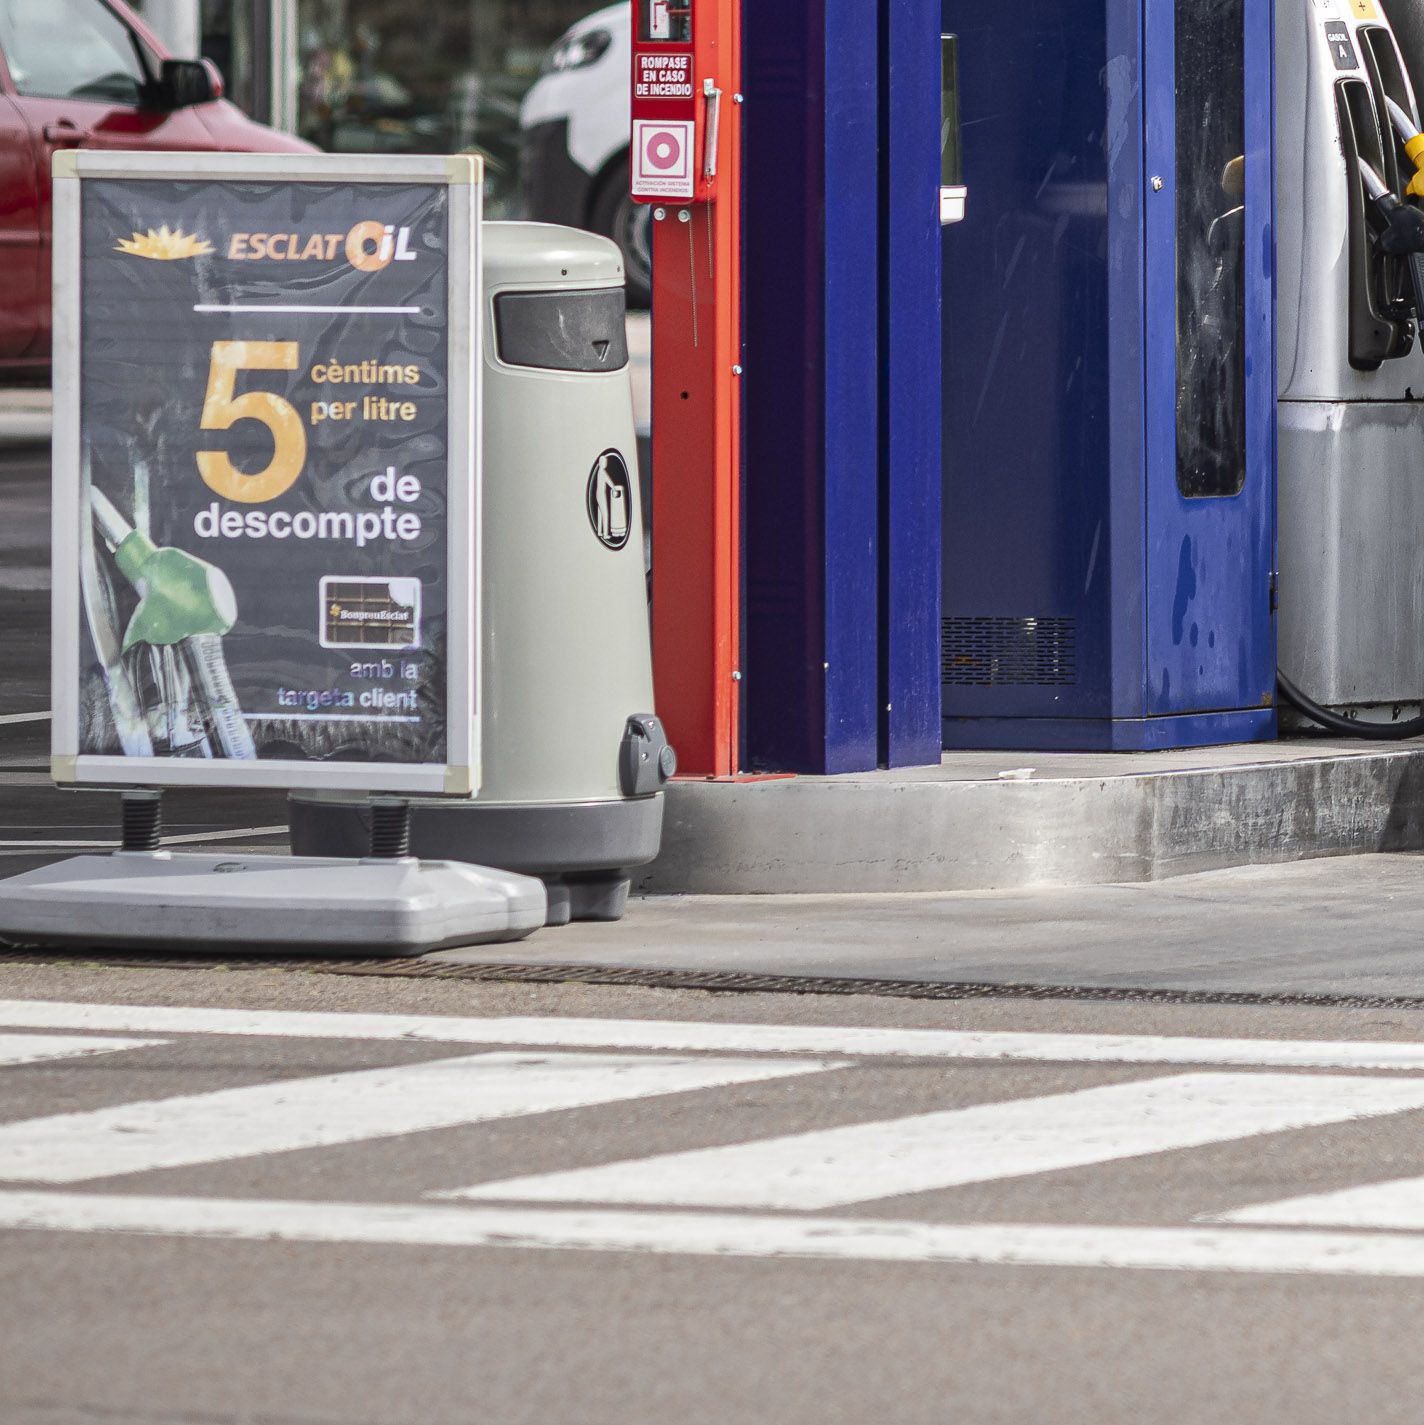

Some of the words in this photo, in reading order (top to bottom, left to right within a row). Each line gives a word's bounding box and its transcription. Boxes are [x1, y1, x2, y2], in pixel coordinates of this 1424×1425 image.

[641, 57, 687, 69] ROMPASE
[1338, 45, 1348, 58] A
[643, 70, 656, 82] EN
[659, 70, 685, 82] CASO
[636, 84, 648, 95] DE
[650, 83, 691, 95] INCENDIO
[311, 357, 420, 387] cèntims
[195, 341, 307, 504] 5
[311, 399, 356, 427] per
[363, 396, 417, 421] litre
[370, 466, 421, 503] de
[193, 503, 421, 548] descompte
[350, 659, 394, 679] amb
[401, 660, 418, 679] la
[277, 687, 355, 710] targeta
[359, 687, 418, 709] client
